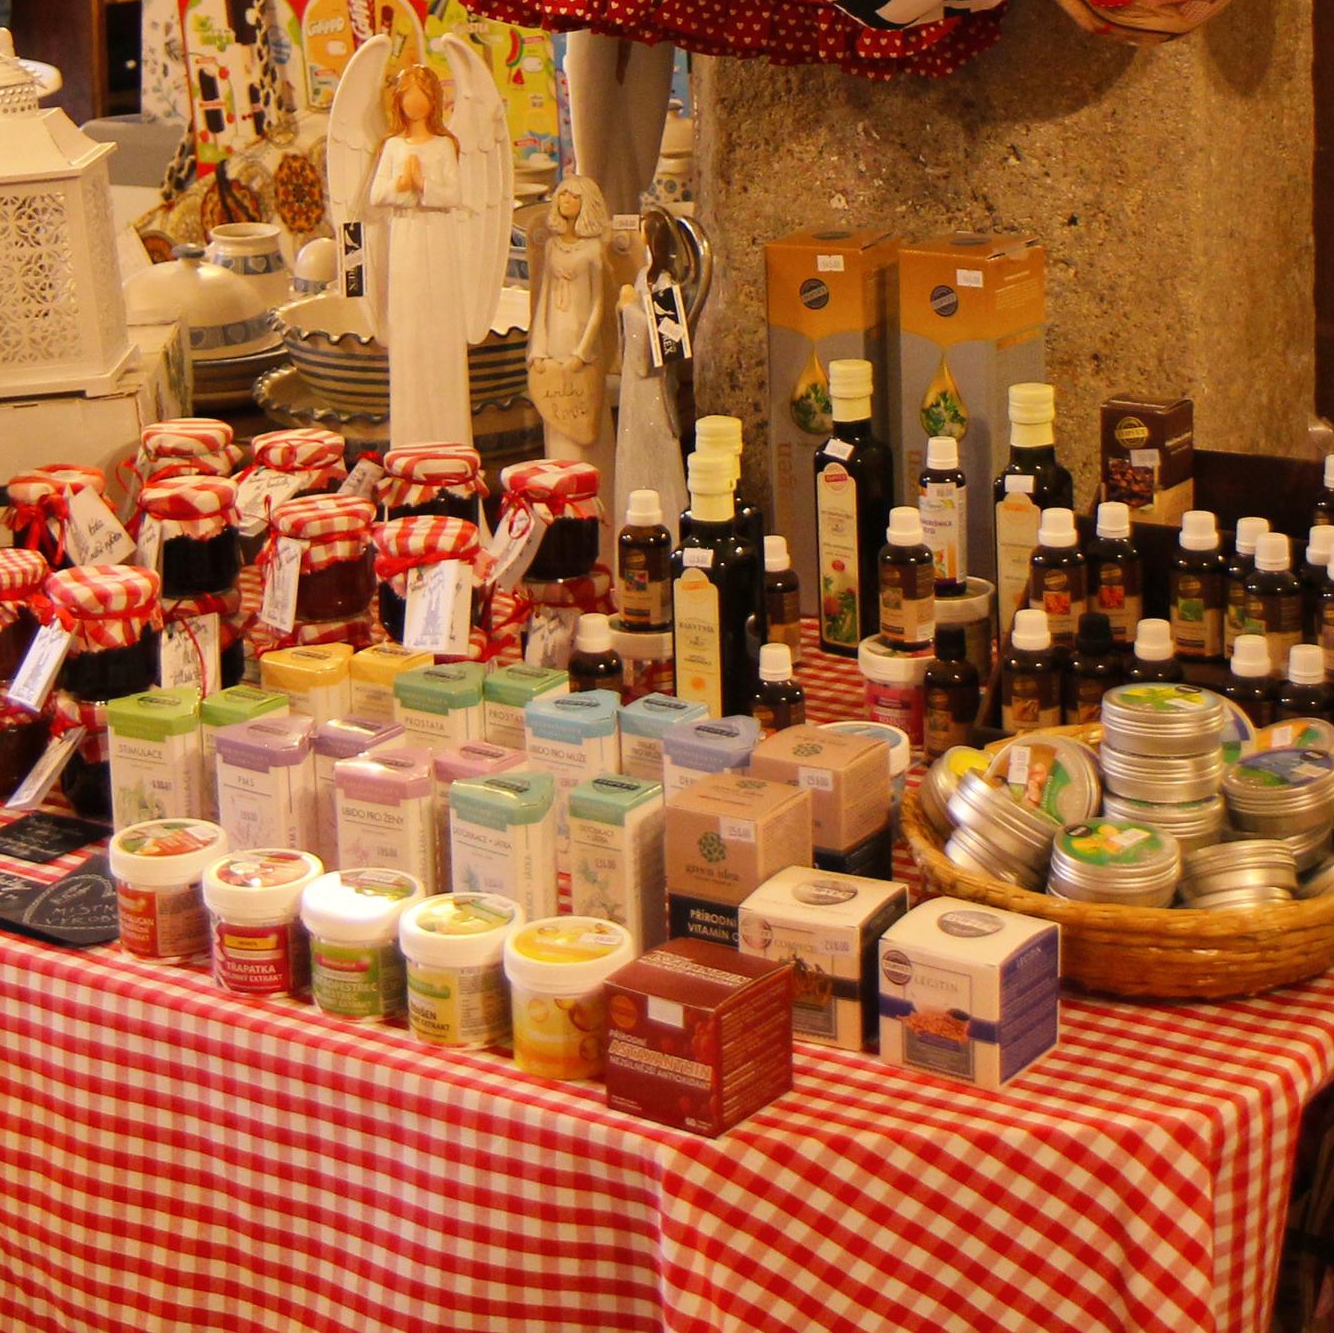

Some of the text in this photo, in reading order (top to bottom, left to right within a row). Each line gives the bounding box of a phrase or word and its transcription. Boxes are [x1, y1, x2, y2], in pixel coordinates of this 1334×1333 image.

[405, 716, 445, 732] PROSTATA
[117, 743, 164, 760] STIMULACE
[225, 960, 276, 975] TŘAPATKA
[914, 974, 959, 993] LEGITIN
